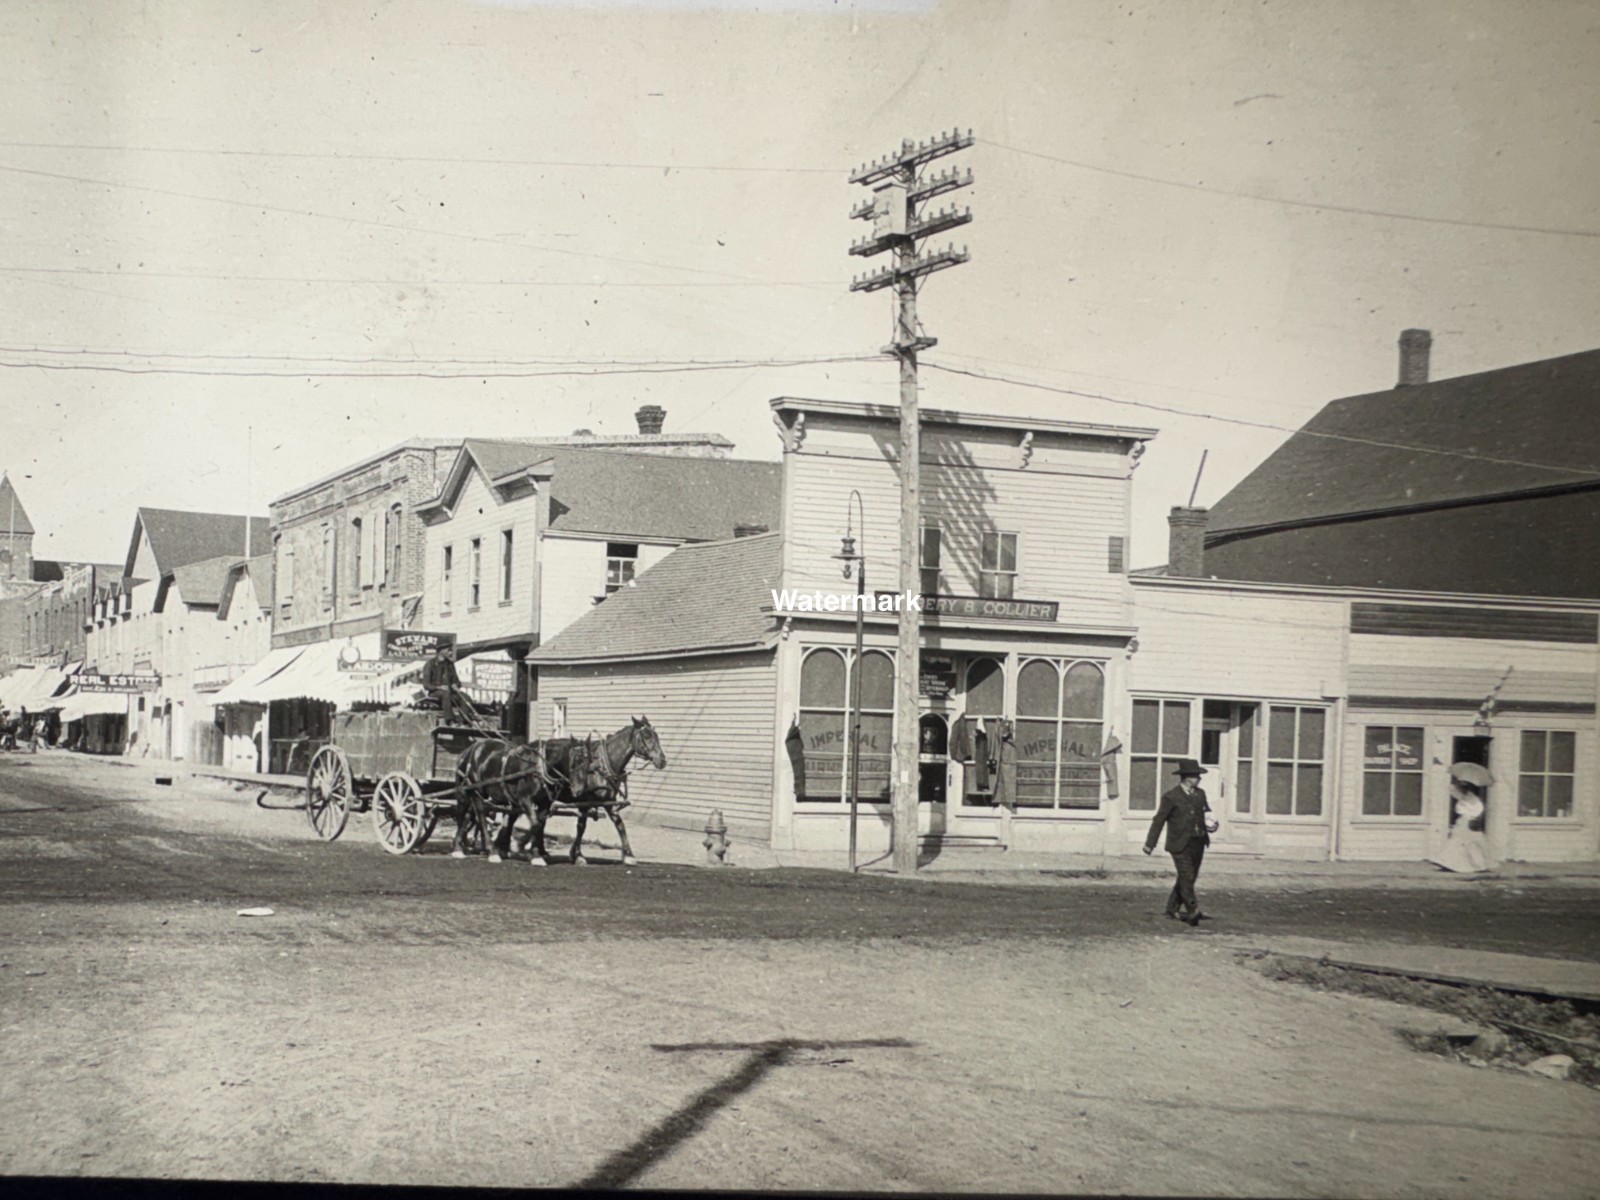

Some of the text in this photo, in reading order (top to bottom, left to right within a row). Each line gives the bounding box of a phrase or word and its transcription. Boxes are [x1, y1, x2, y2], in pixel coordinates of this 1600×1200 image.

[983, 601, 1051, 618] COLLIER
[69, 675, 106, 685] REAL
[810, 730, 878, 749] IMPERAL
